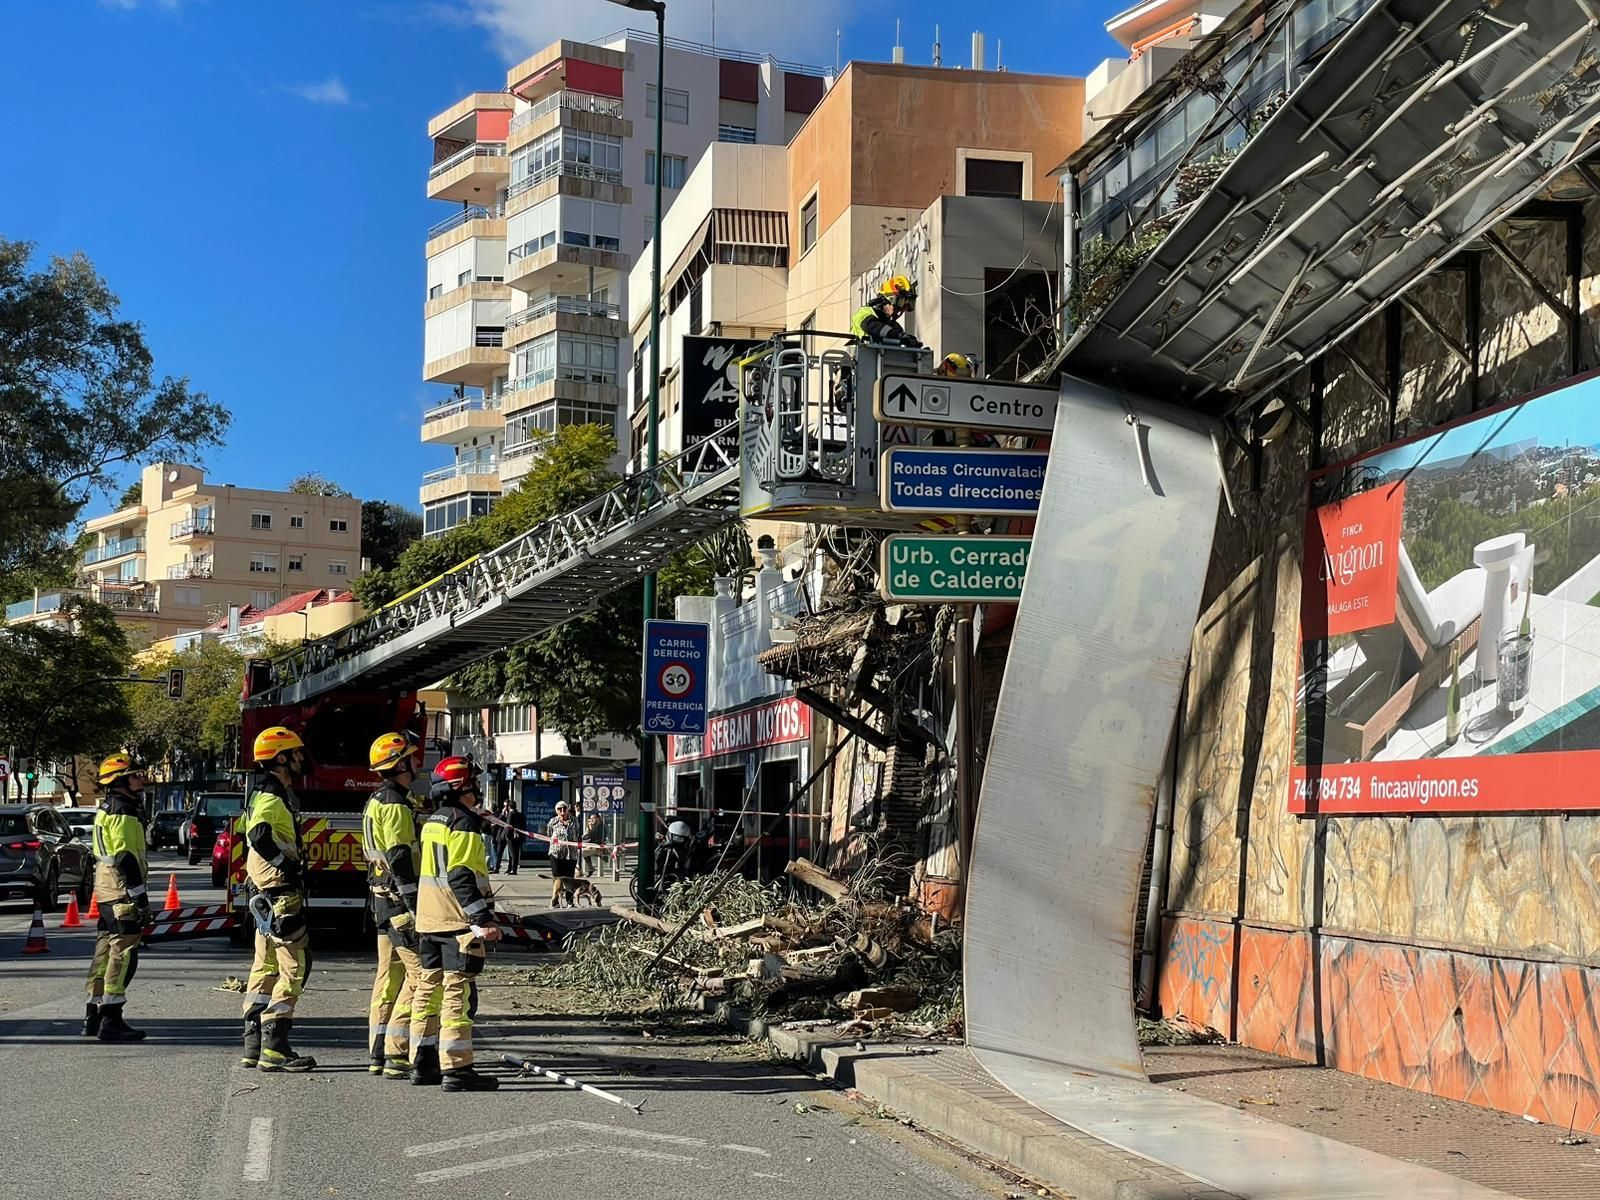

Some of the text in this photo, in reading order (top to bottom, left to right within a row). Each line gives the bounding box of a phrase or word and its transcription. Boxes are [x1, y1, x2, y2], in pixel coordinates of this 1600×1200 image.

[970, 395, 1043, 417] Centro
[894, 462, 947, 475] Rondas
[894, 481, 1042, 500] Todas direcciones
[1342, 523, 1363, 538] FINCA
[893, 546, 939, 565] Urb.
[894, 570, 920, 588] de
[1353, 596, 1369, 610] ESTE
[659, 638, 696, 648] CARRIL
[653, 649, 701, 659] DERECHO
[665, 673, 687, 687] 30
[647, 701, 704, 711] PREFERENCIA
[711, 713, 751, 751] SERBAN
[756, 700, 799, 741] MOTOS
[586, 788, 623, 797] 3 8 11
[1294, 774, 1479, 805] 744 784 734 fincaavignon.es
[612, 801, 624, 809] N1
